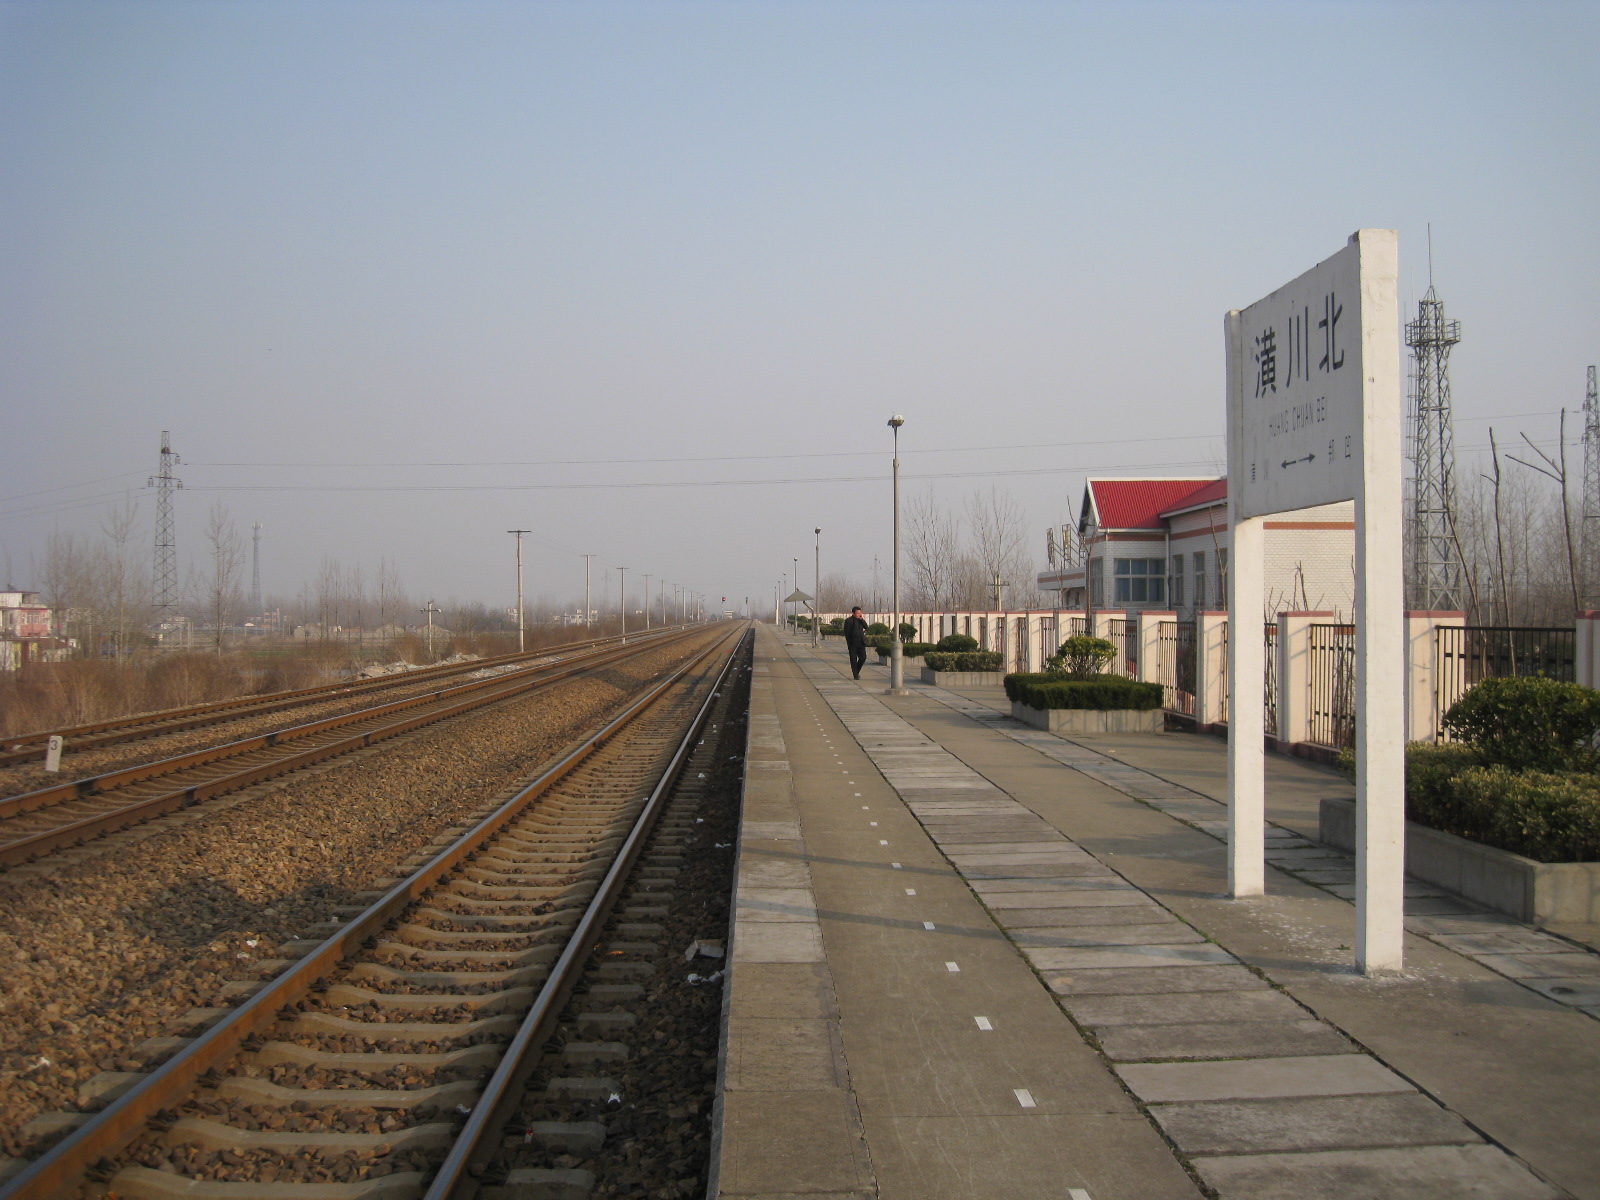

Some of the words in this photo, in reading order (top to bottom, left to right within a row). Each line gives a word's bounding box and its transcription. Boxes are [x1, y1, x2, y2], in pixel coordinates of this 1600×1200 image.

[1255, 291, 1345, 399] 潢川北
[1292, 402, 1314, 431] CHUAN
[50, 739, 58, 751] 3
